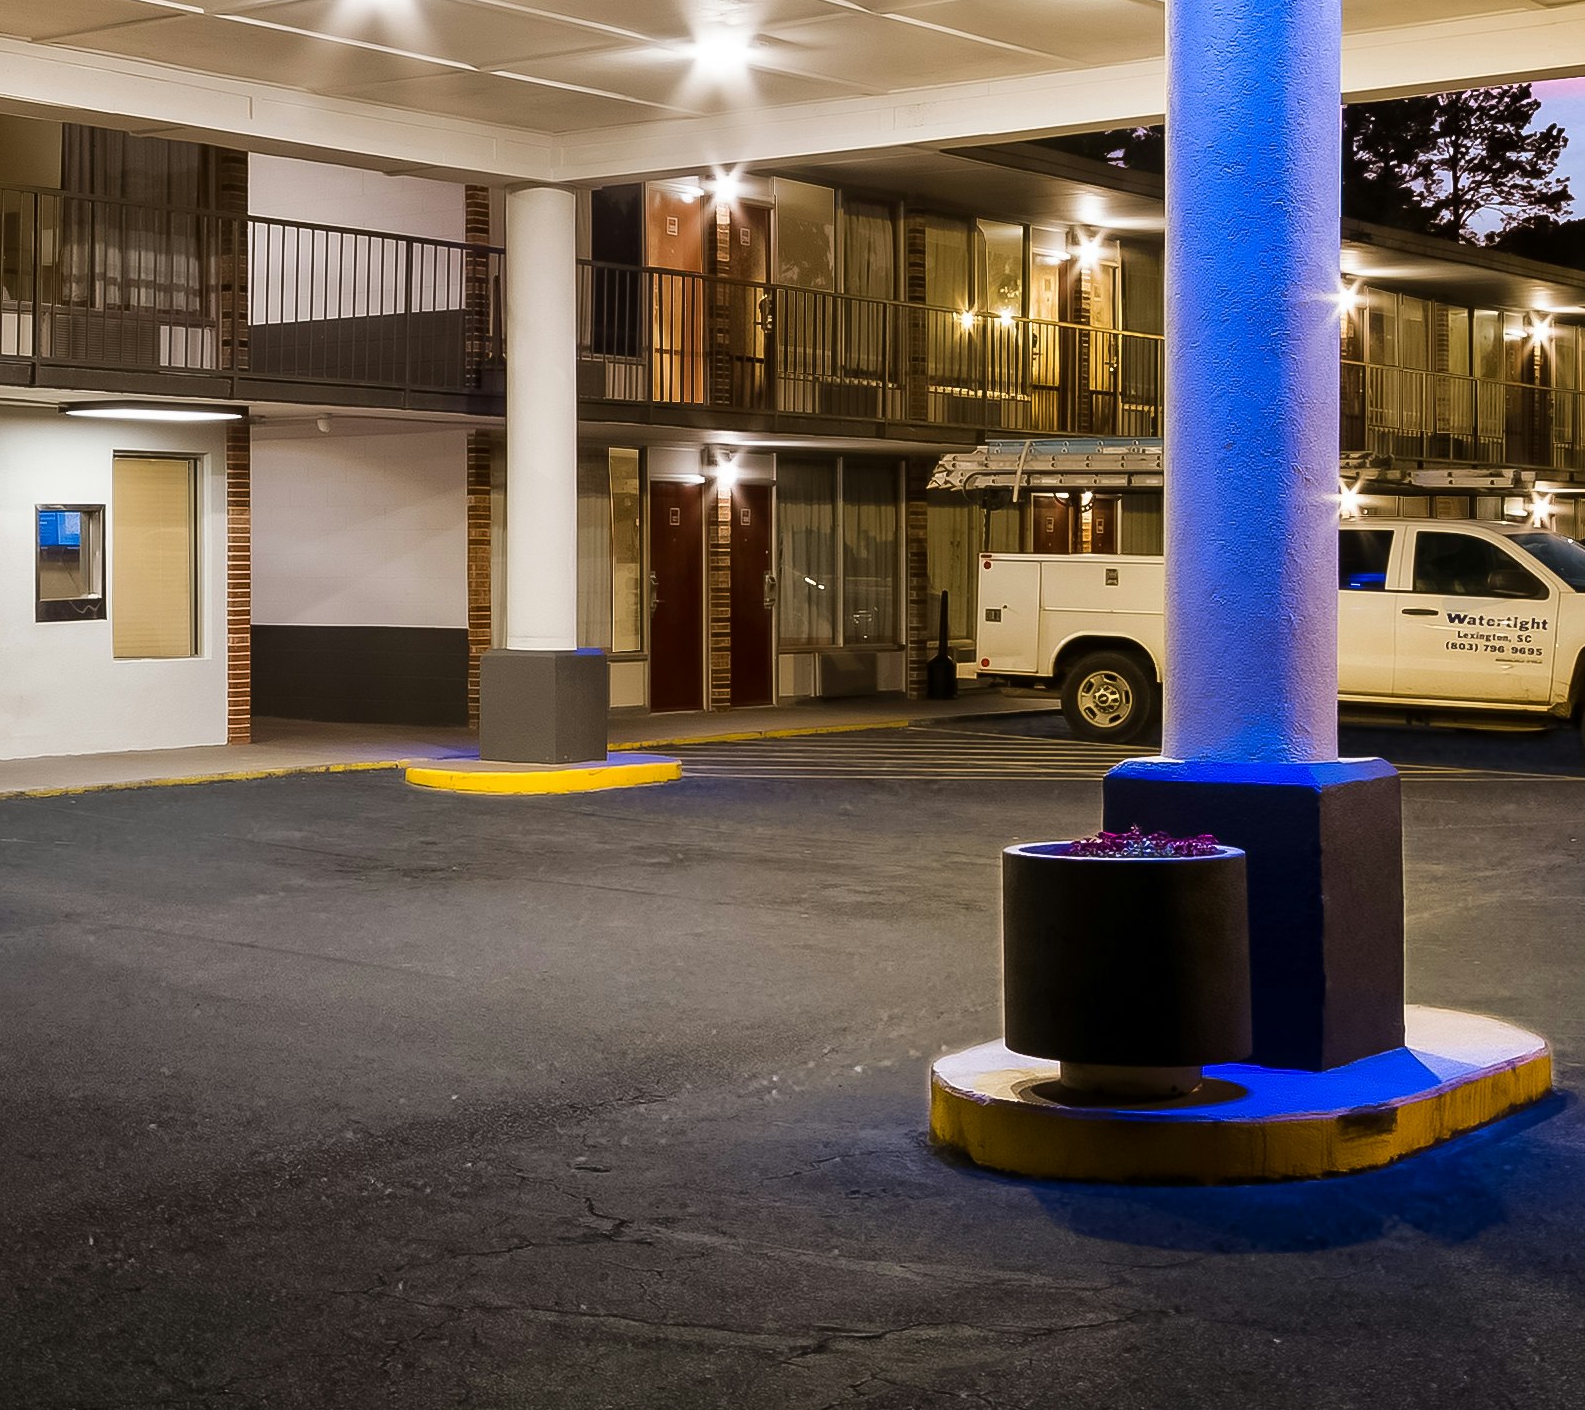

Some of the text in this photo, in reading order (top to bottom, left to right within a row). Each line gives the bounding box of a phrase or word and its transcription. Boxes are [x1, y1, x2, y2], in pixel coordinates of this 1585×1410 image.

[1446, 612, 1549, 632] Watertight
[1516, 634, 1532, 644] SC
[1445, 641, 1479, 653] (803)
